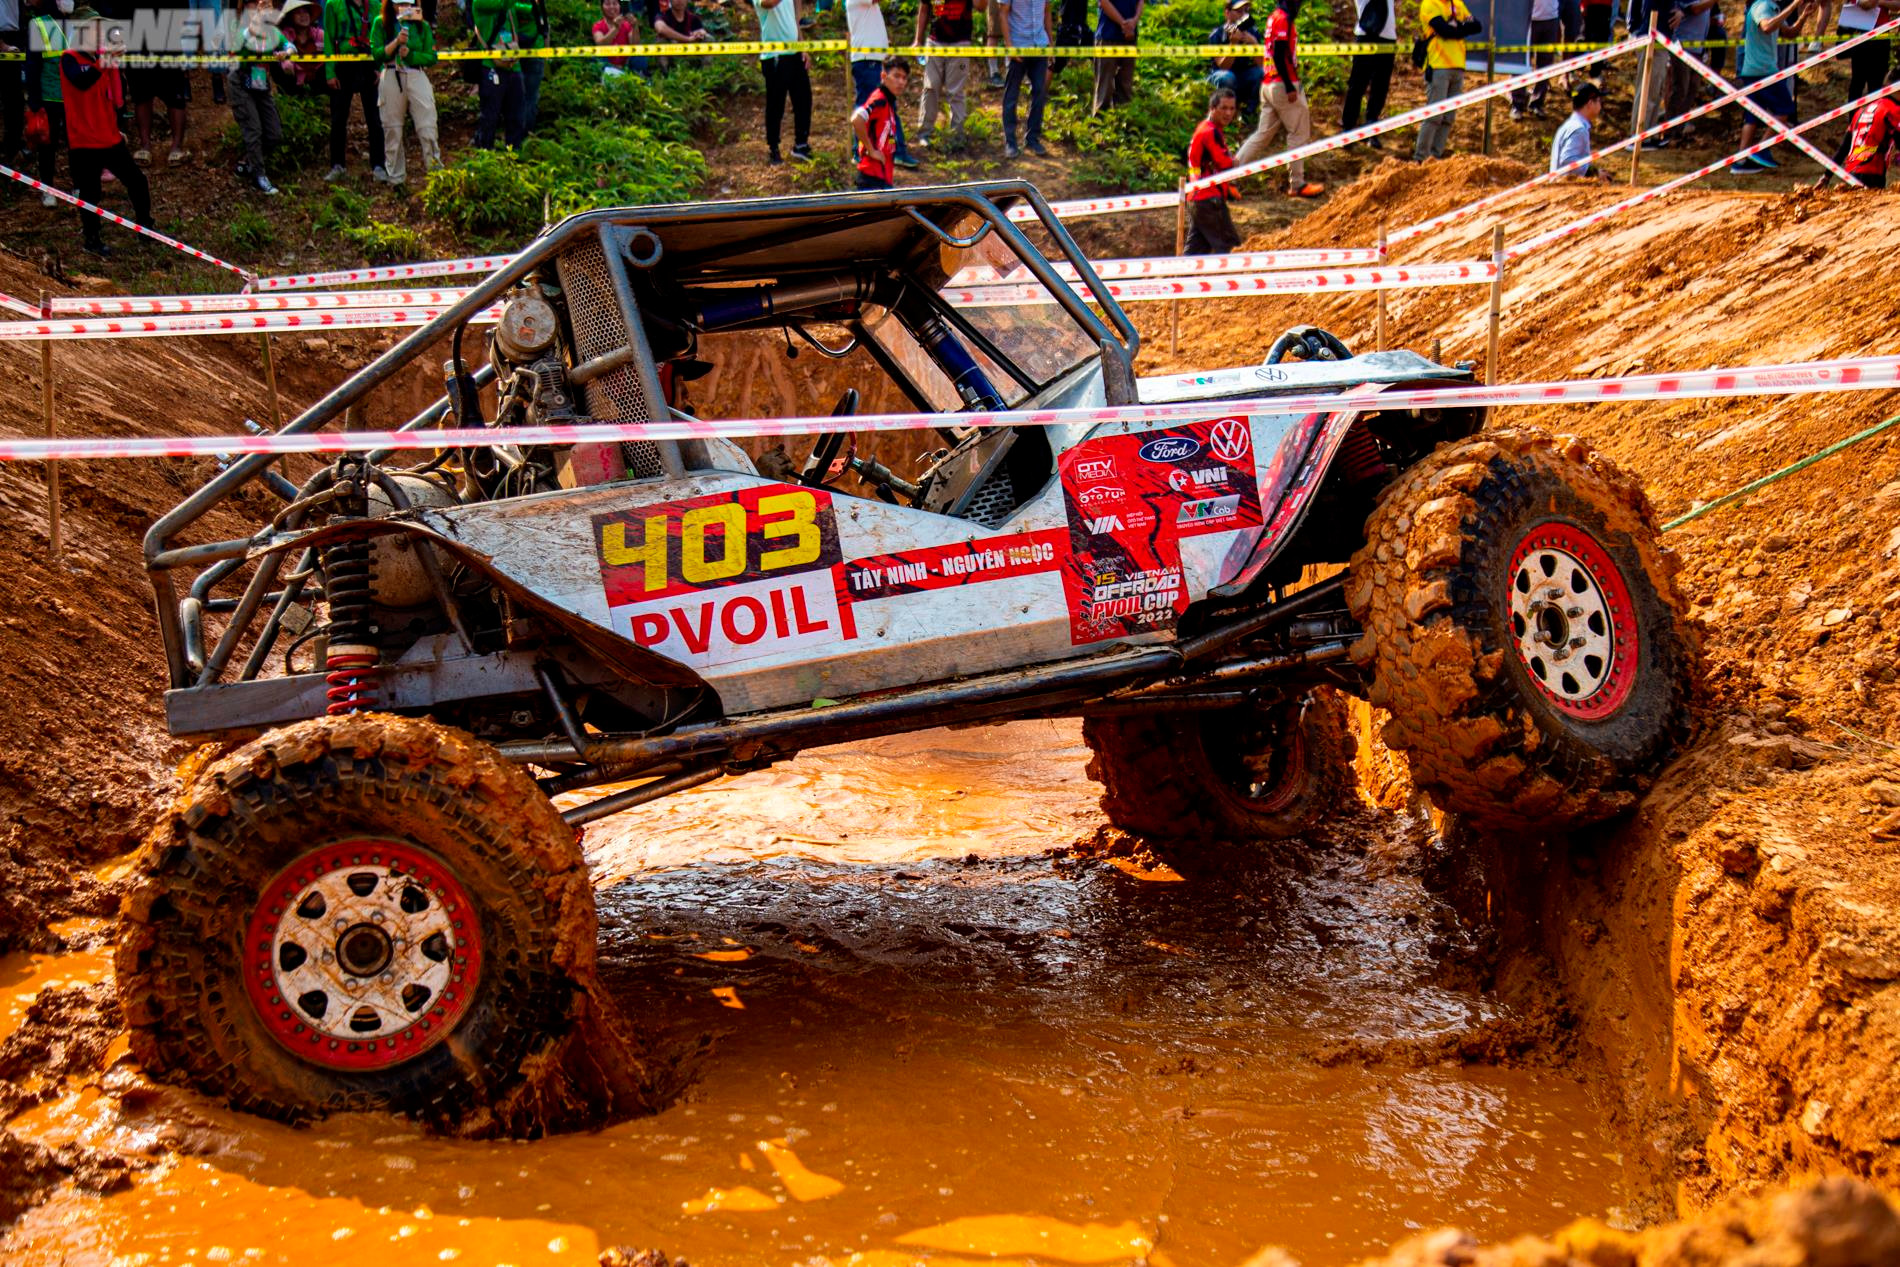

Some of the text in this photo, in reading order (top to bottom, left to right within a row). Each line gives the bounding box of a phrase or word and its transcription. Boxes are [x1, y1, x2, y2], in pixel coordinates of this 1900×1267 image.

[1151, 440, 1188, 459] Ford
[1078, 460, 1112, 473] OTV
[1079, 469, 1115, 480] MEDIA
[1191, 466, 1228, 484] VNI
[602, 491, 821, 592] 403
[851, 567, 881, 591] TÂY
[886, 562, 928, 584] NINH
[942, 549, 1005, 576] NGUYÊN
[1009, 543, 1054, 566] NGỌC
[1125, 566, 1180, 581] VIETNAM
[1094, 574, 1180, 601] OFFROAD
[1092, 590, 1179, 622] PVOIL CUP
[631, 585, 828, 655] PVOIL
[1137, 609, 1173, 625] 2022
